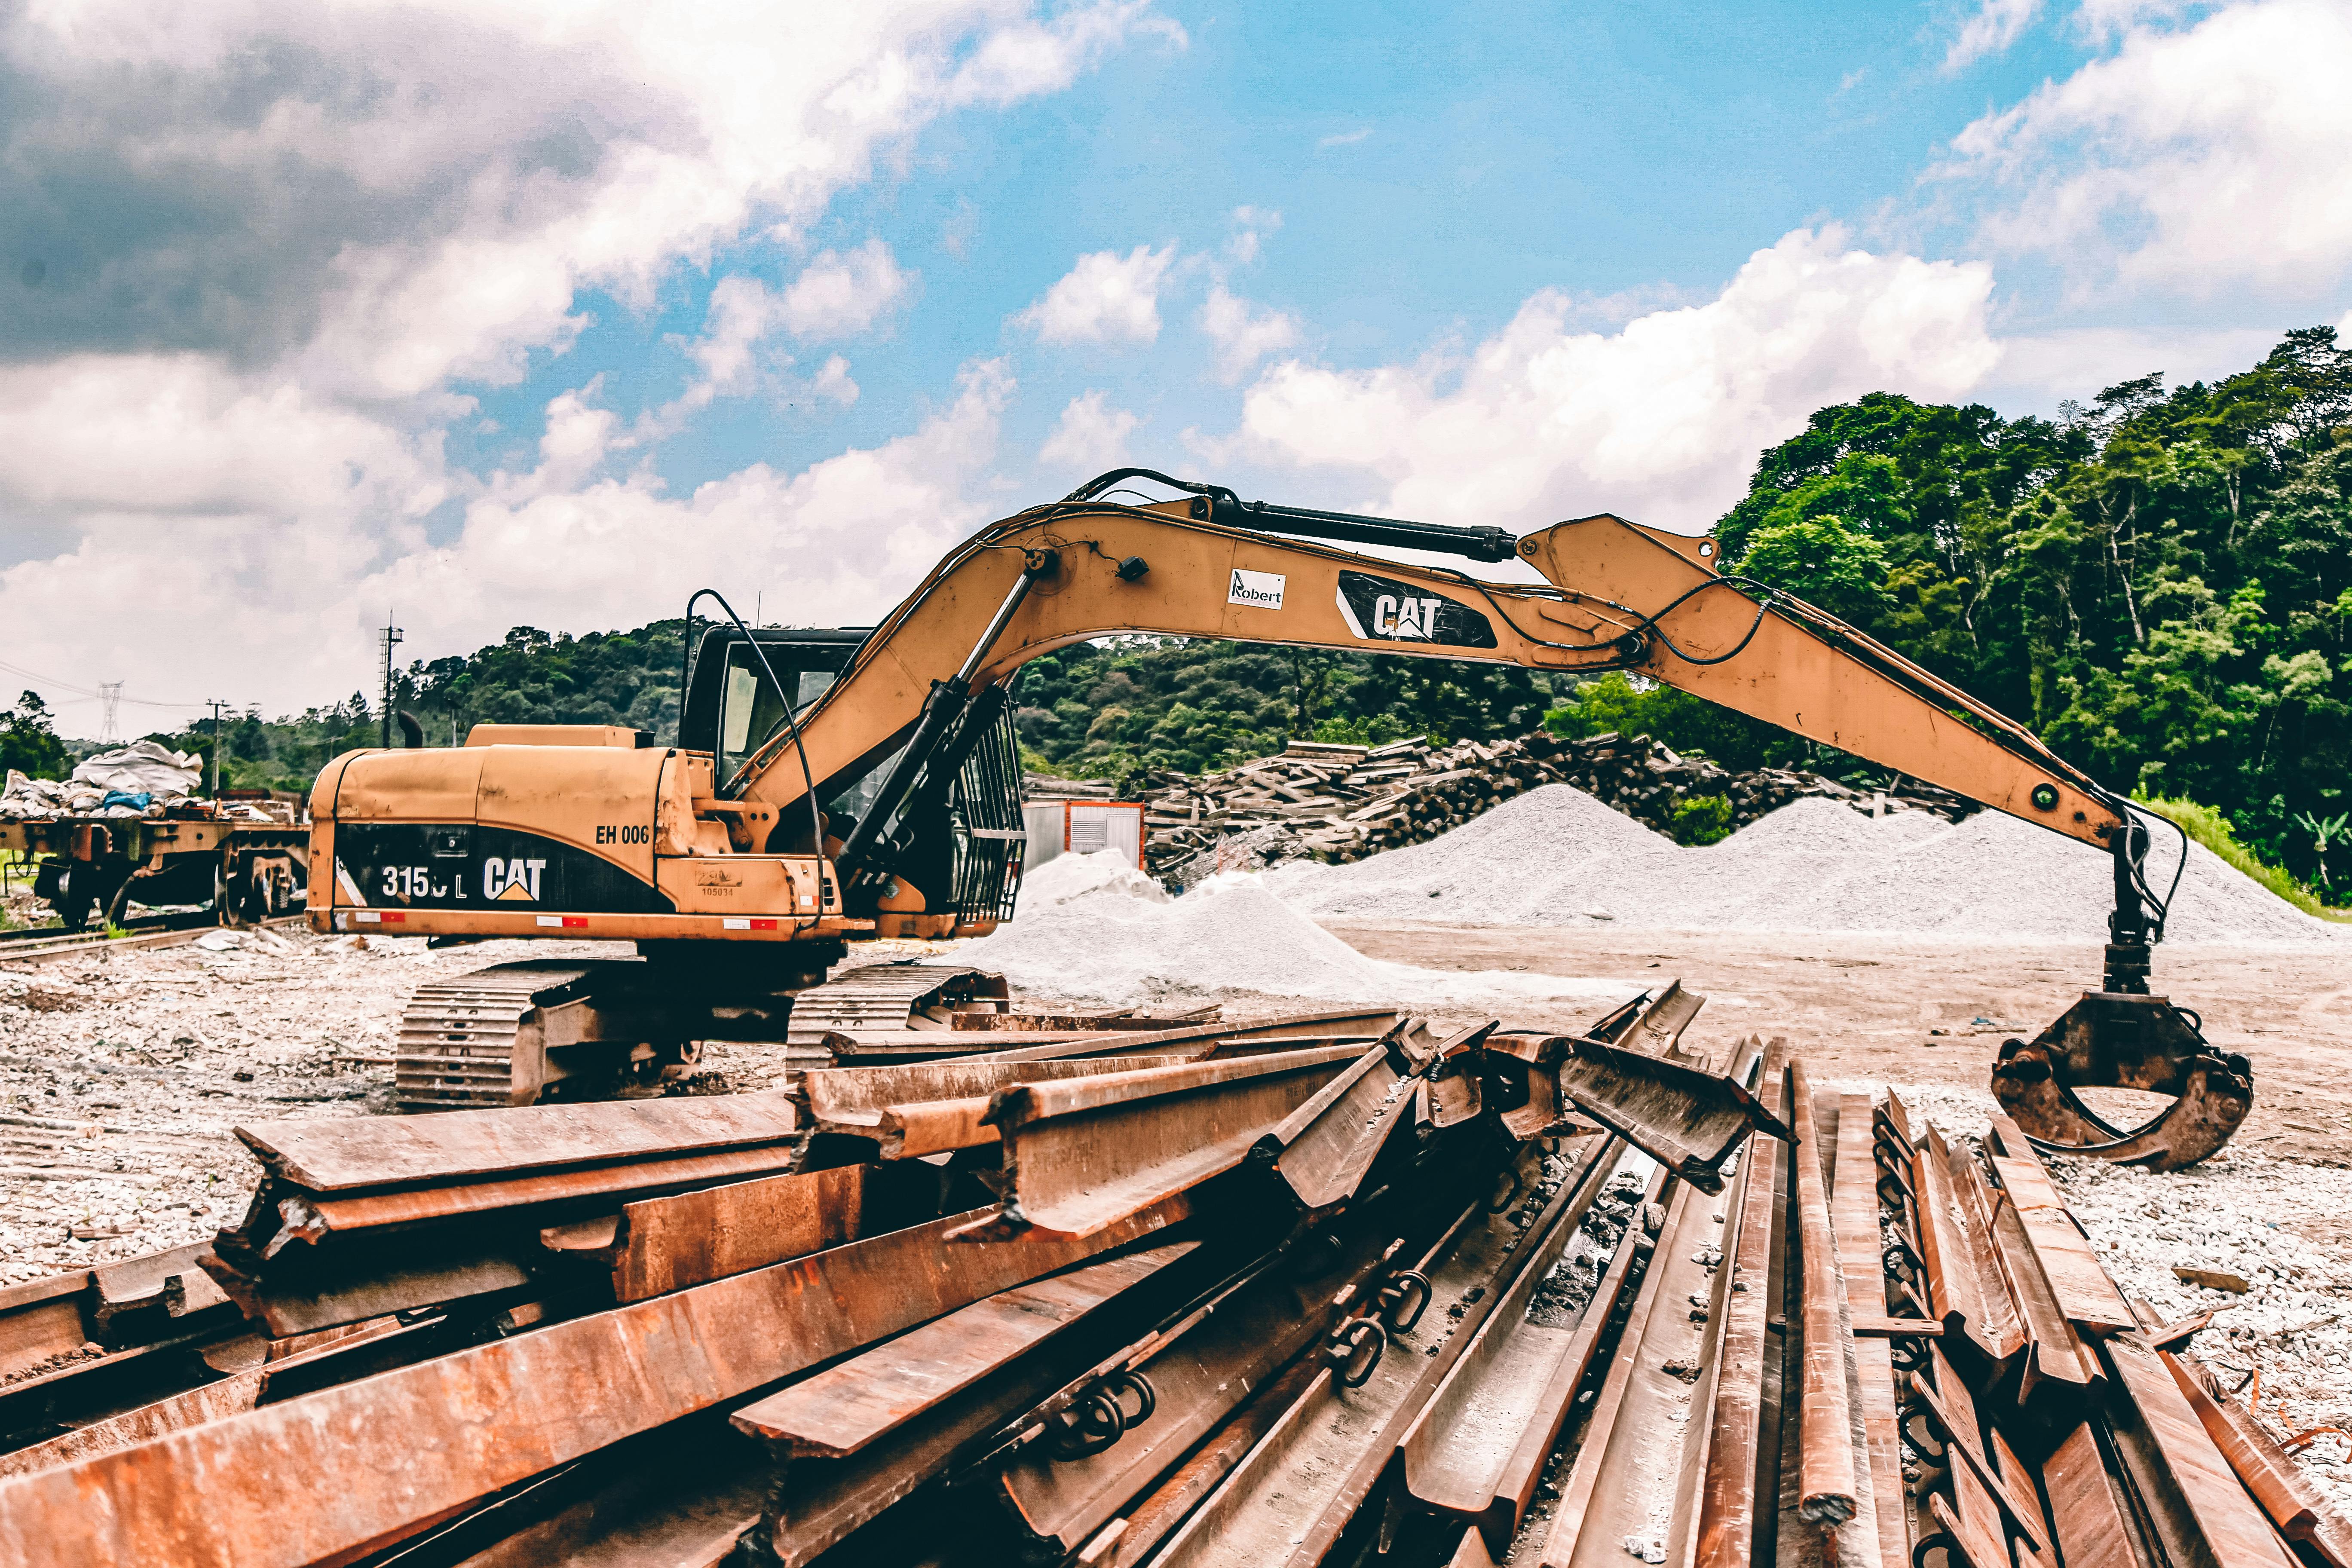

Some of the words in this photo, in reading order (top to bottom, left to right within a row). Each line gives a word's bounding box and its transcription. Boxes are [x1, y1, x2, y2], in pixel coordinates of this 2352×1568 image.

[1231, 570, 1281, 603] Robert
[1374, 594, 1442, 639] CAT
[596, 825, 617, 844] EH
[622, 825, 649, 844] 006
[484, 857, 546, 901] CAT
